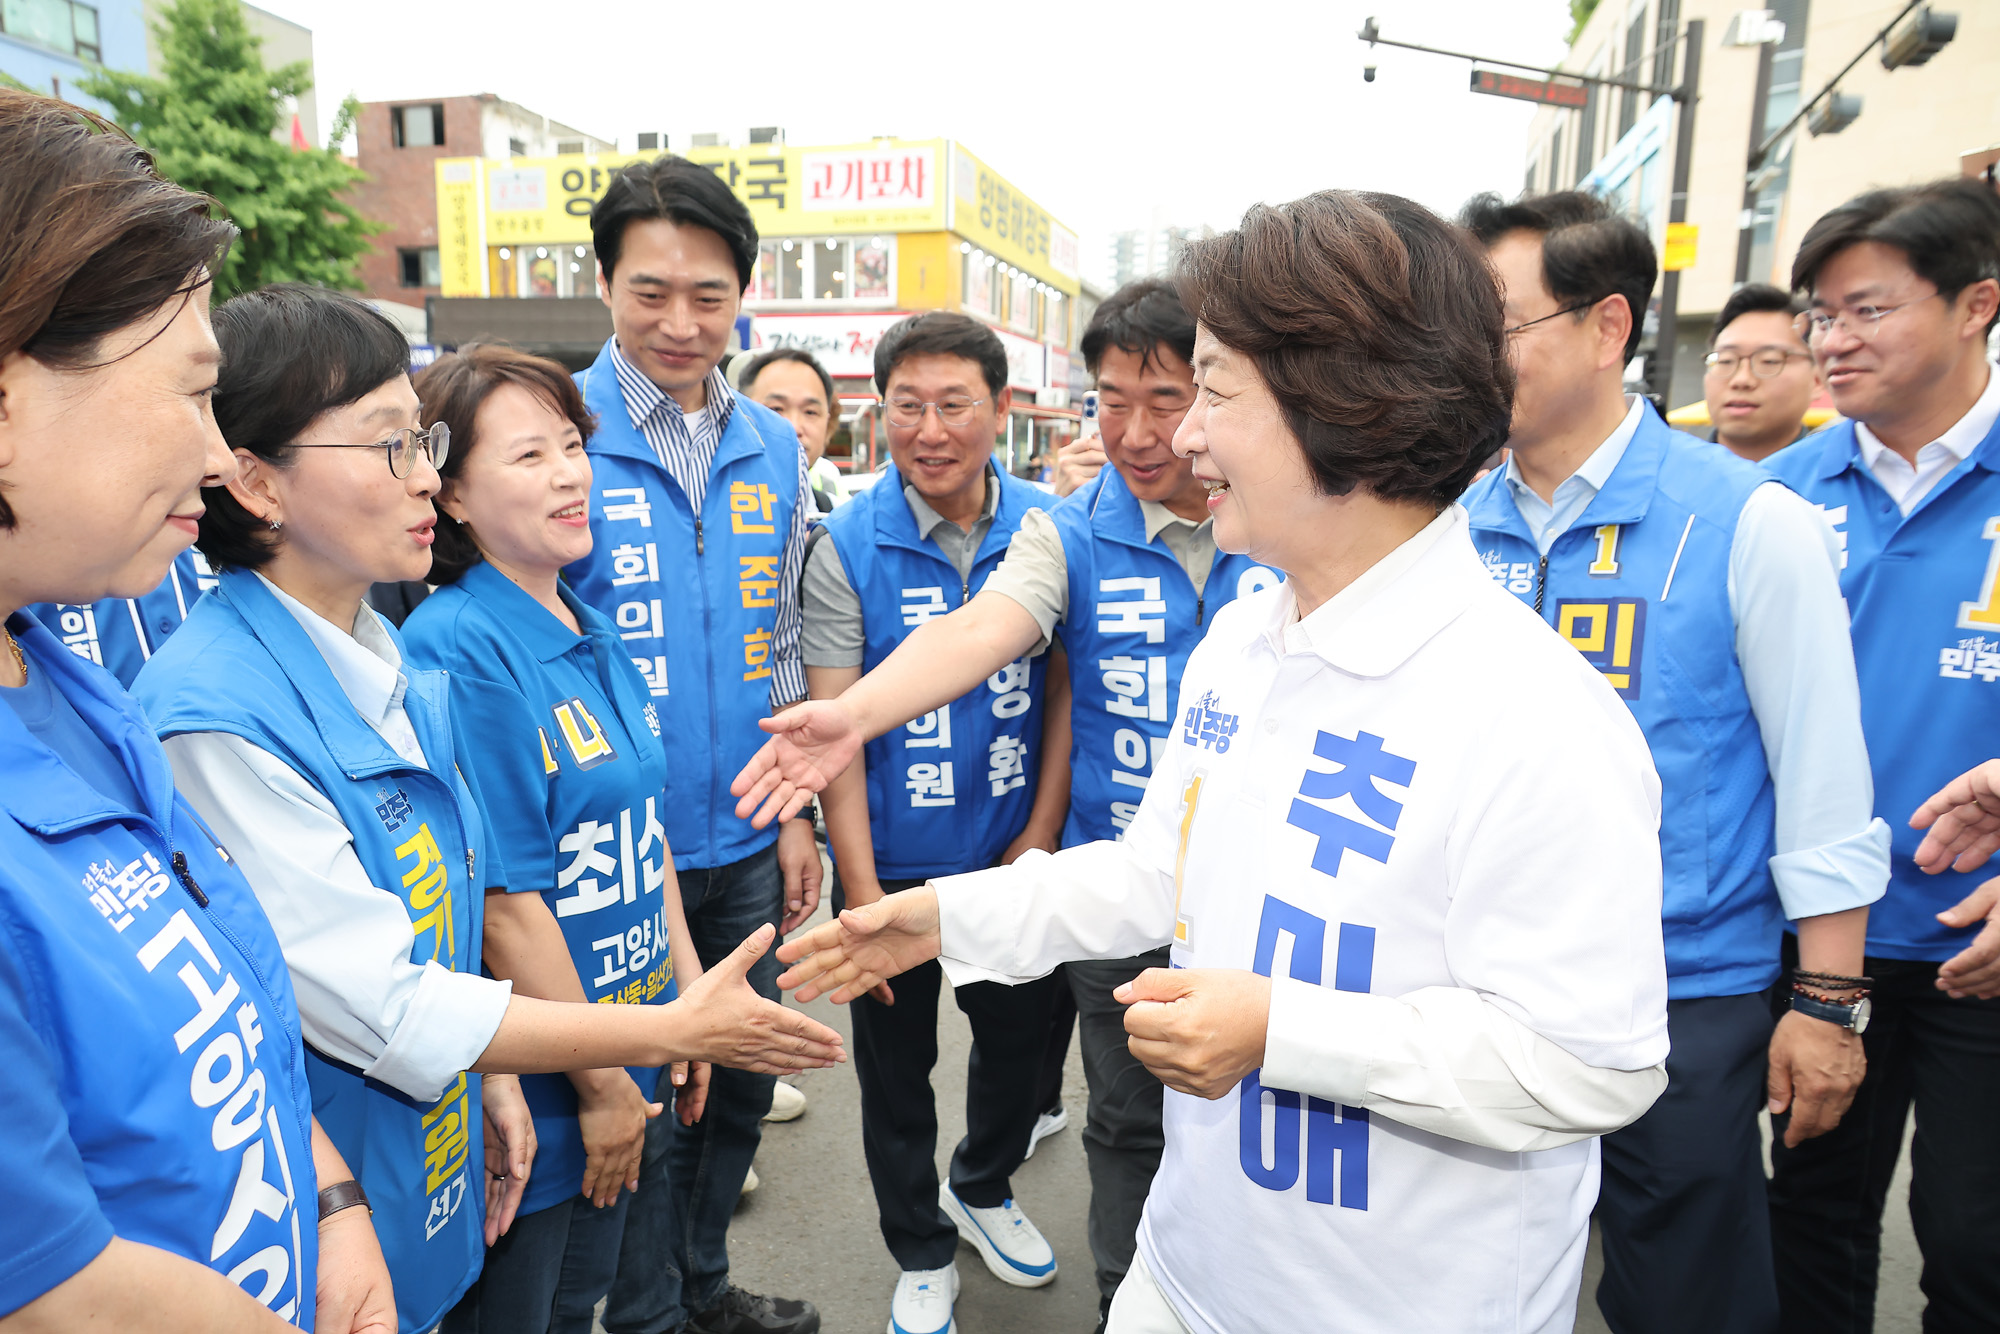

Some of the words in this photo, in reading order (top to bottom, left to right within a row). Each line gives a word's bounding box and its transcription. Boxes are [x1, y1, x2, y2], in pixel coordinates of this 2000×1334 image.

[811, 156, 925, 201] 고기포차
[730, 481, 778, 682] 한준호
[1589, 524, 1620, 575] 1
[602, 487, 669, 697] 국회의원
[901, 586, 956, 808] 국의원
[1184, 706, 1240, 754] 민주당
[82, 858, 119, 893] 더불어
[88, 850, 170, 934] 민주당
[592, 903, 669, 988] 고양시
[1240, 729, 1417, 1211] 추미애
[425, 1172, 467, 1242] 선거
